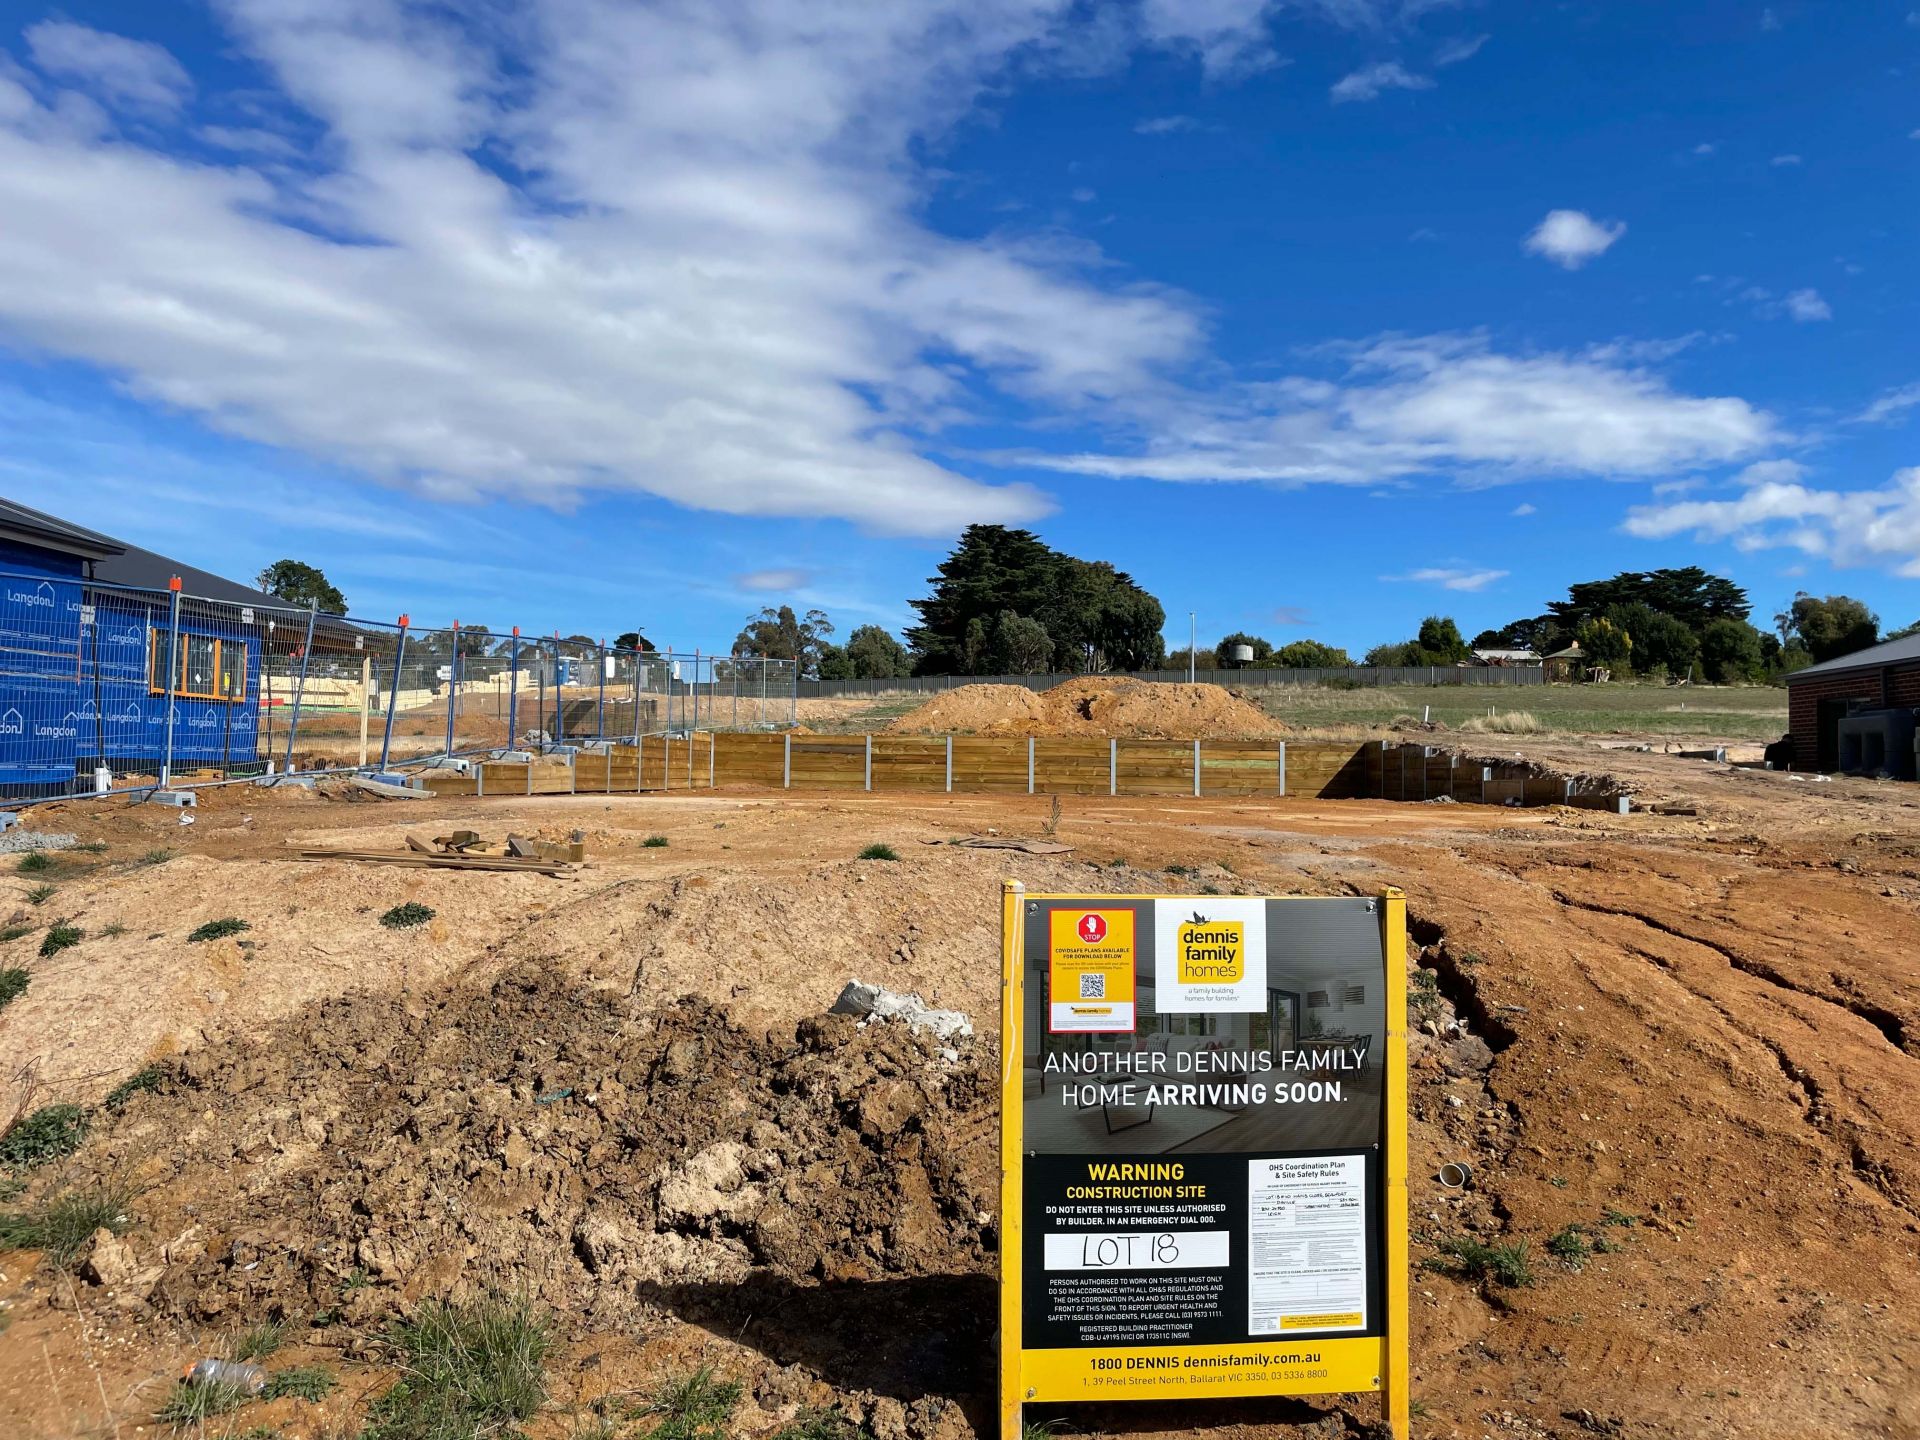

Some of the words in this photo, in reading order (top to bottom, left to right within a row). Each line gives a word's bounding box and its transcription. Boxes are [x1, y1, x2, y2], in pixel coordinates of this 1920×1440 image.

[8, 587, 54, 607] Langdon
[108, 629, 140, 645] Langdon
[107, 710, 139, 723] Langdon
[189, 714, 216, 729] Langdon
[36, 719, 76, 738] Langdon
[1183, 928, 1239, 943] dennis
[1185, 946, 1236, 964] family
[1186, 962, 1236, 977] homes
[1193, 987, 1210, 995] family
[1043, 1052, 1166, 1073] ANOTHER
[1176, 1051, 1272, 1073] DENNIS
[1281, 1049, 1366, 1071] FAMILY
[1062, 1085, 1136, 1106] HOME
[1144, 1083, 1267, 1106] ARRIVING
[1274, 1081, 1348, 1103] SOON.
[1088, 1164, 1184, 1181] WARNING
[1285, 1162, 1328, 1170] Coordination
[1297, 1171, 1318, 1179] Safety
[1066, 1186, 1172, 1199] CONSTRUCTION
[1176, 1185, 1206, 1198] SITE
[1046, 1206, 1057, 1214] DO
[1059, 1206, 1075, 1214] NOT
[1076, 1206, 1103, 1214] ENTER
[1104, 1205, 1123, 1214] THIS
[1124, 1205, 1142, 1213] SITE
[1144, 1205, 1175, 1213] UNLESS
[1176, 1204, 1226, 1212] AUTHORISED
[1056, 1217, 1066, 1225] BY
[1068, 1217, 1105, 1225] BUILDER.
[1107, 1217, 1116, 1225] IN
[1117, 1217, 1129, 1225] AN
[1130, 1216, 1179, 1224] EMERGENCY
[1180, 1216, 1198, 1224] DIAL
[1082, 1235, 1140, 1266] LOT
[1151, 1234, 1179, 1263] 18
[1180, 1302, 1203, 1310] HEALTH
[1047, 1314, 1071, 1322] SAFETY
[1090, 1358, 1122, 1370] 1800
[1126, 1357, 1179, 1369] DENNIS
[1184, 1353, 1321, 1369] dennisfamily.com.au
[1083, 1378, 1090, 1387] 1,
[1092, 1377, 1104, 1386] 39
[1106, 1376, 1126, 1386] Peel
[1128, 1376, 1156, 1385] Street
[1159, 1375, 1187, 1385] North,
[1190, 1374, 1226, 1383] Ballarat
[1228, 1373, 1243, 1382] VIC
[1245, 1372, 1269, 1382] 3350,
[1271, 1372, 1282, 1380] 03
[1284, 1370, 1305, 1380] 5336
[1307, 1369, 1328, 1378] 8800
